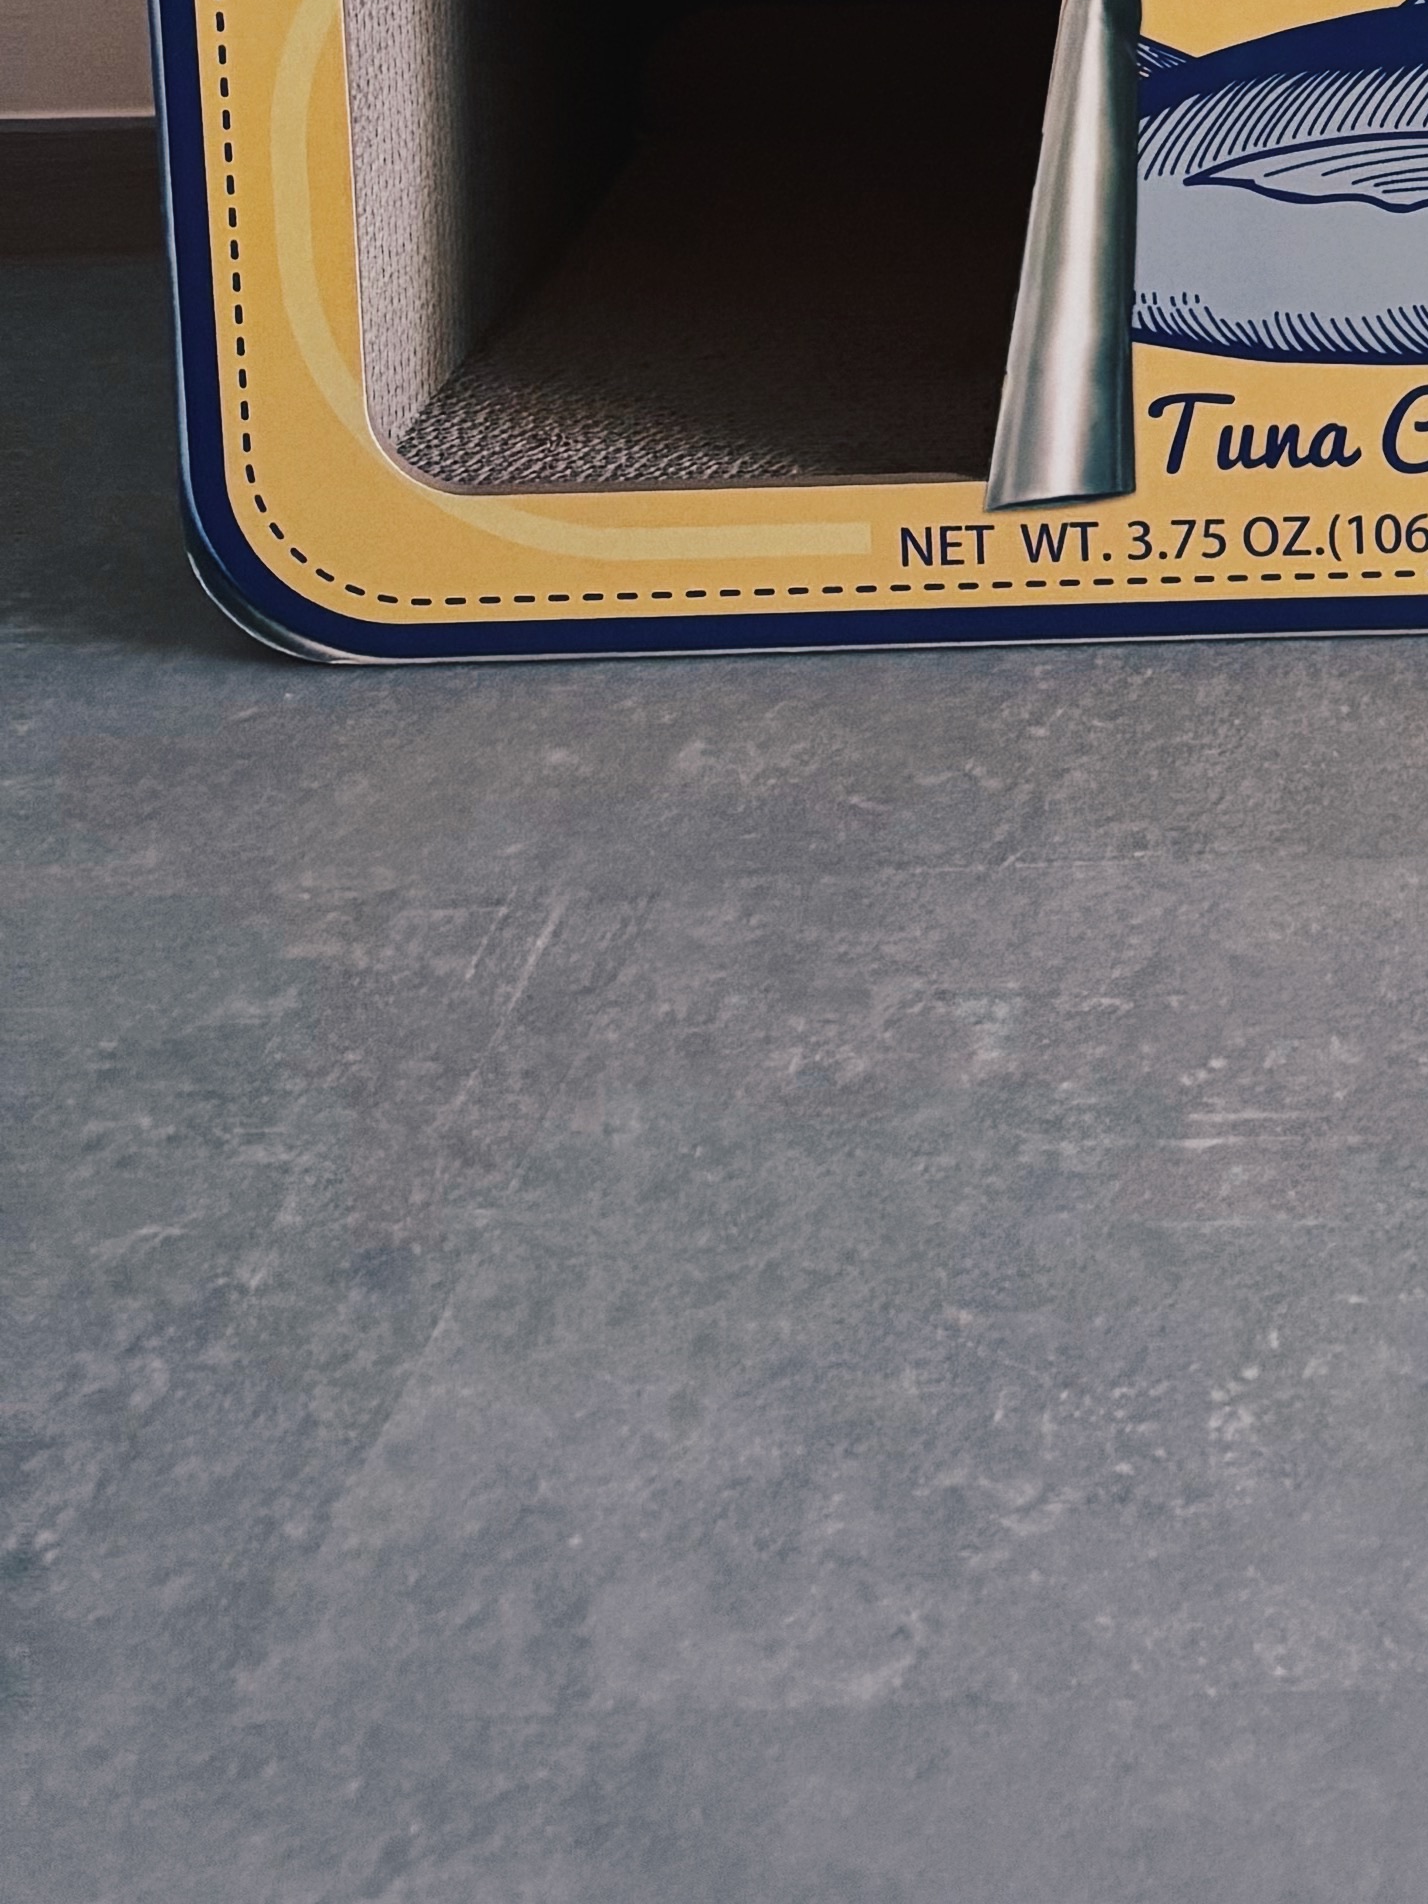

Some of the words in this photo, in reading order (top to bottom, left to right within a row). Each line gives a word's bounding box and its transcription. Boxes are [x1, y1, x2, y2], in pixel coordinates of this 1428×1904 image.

[1147, 392, 1362, 475] Tuna
[899, 524, 996, 568] NET
[1020, 521, 1113, 564] WT.
[1126, 518, 1228, 561] 3.75
